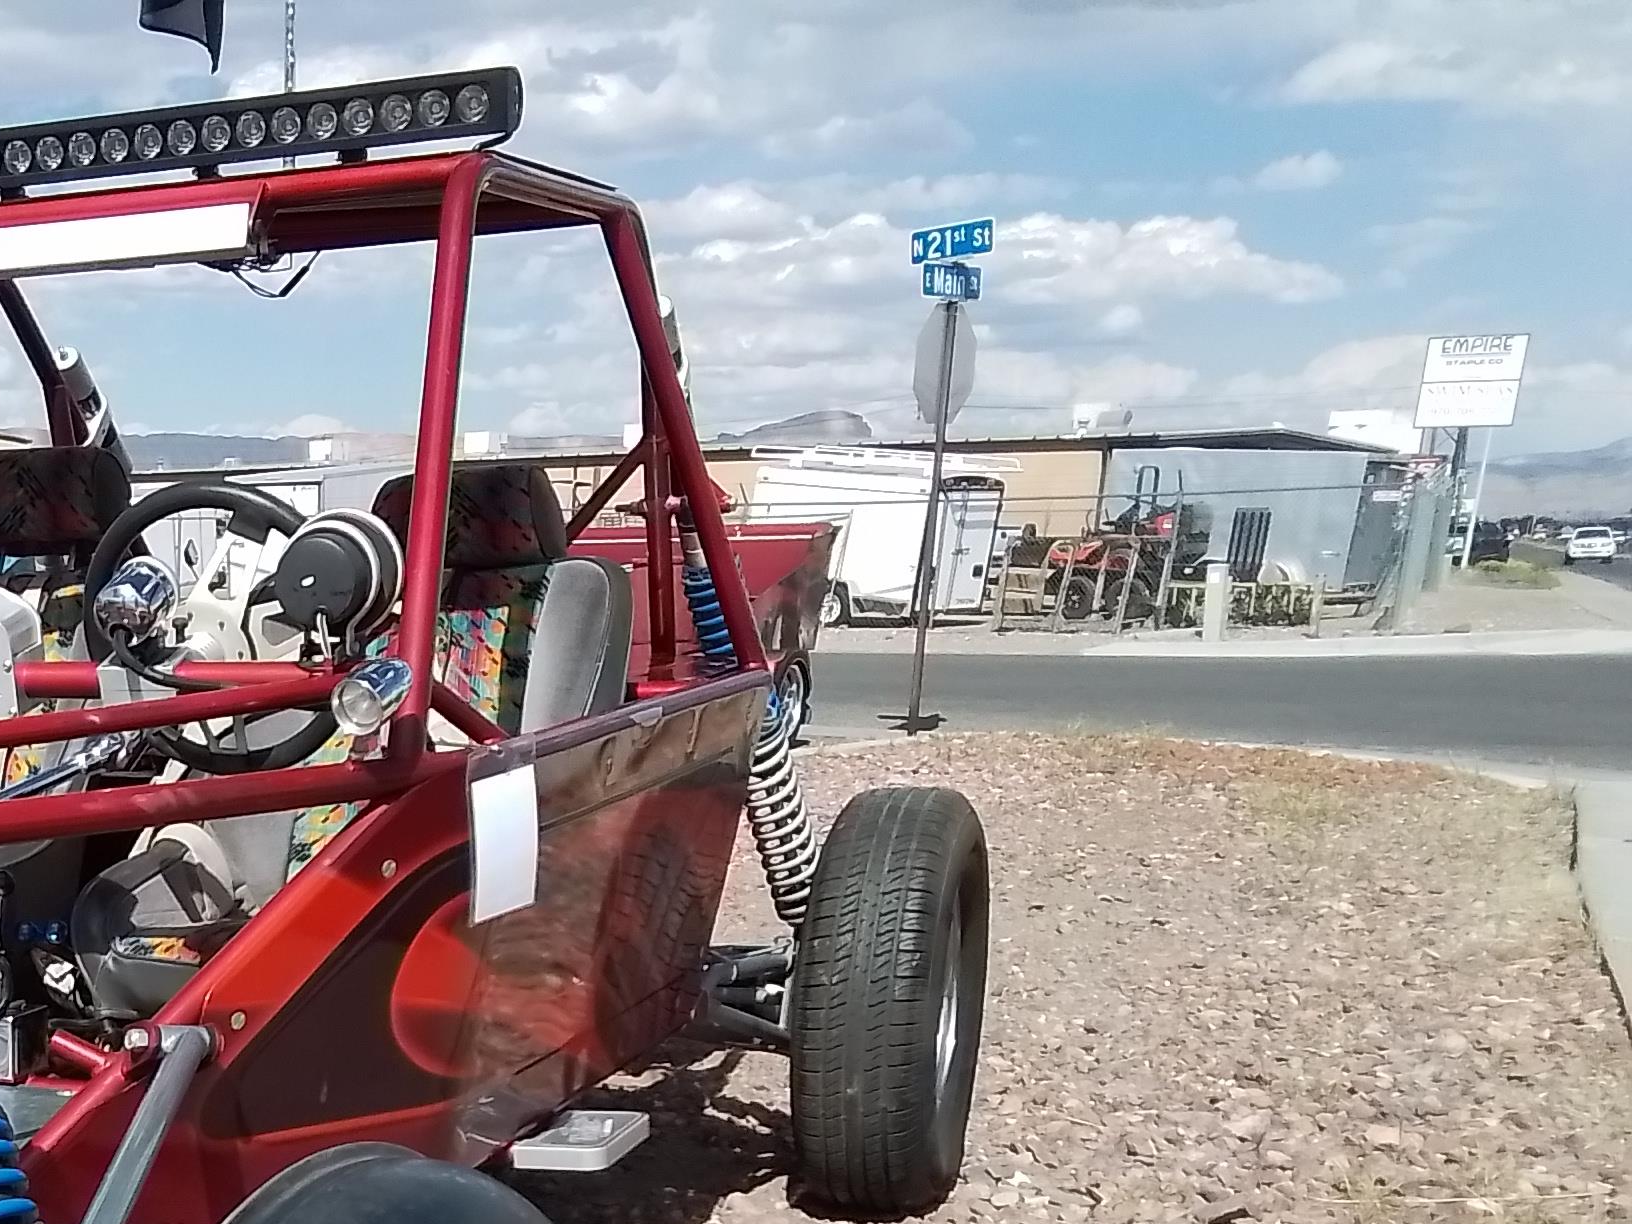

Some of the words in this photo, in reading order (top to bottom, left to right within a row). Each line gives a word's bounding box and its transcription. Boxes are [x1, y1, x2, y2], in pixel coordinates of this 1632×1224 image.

[913, 238, 924, 258] N
[927, 226, 966, 259] 21st
[972, 226, 990, 247] St
[925, 273, 932, 288] E
[933, 267, 966, 295] Main
[1441, 336, 1514, 354] EMPIRE
